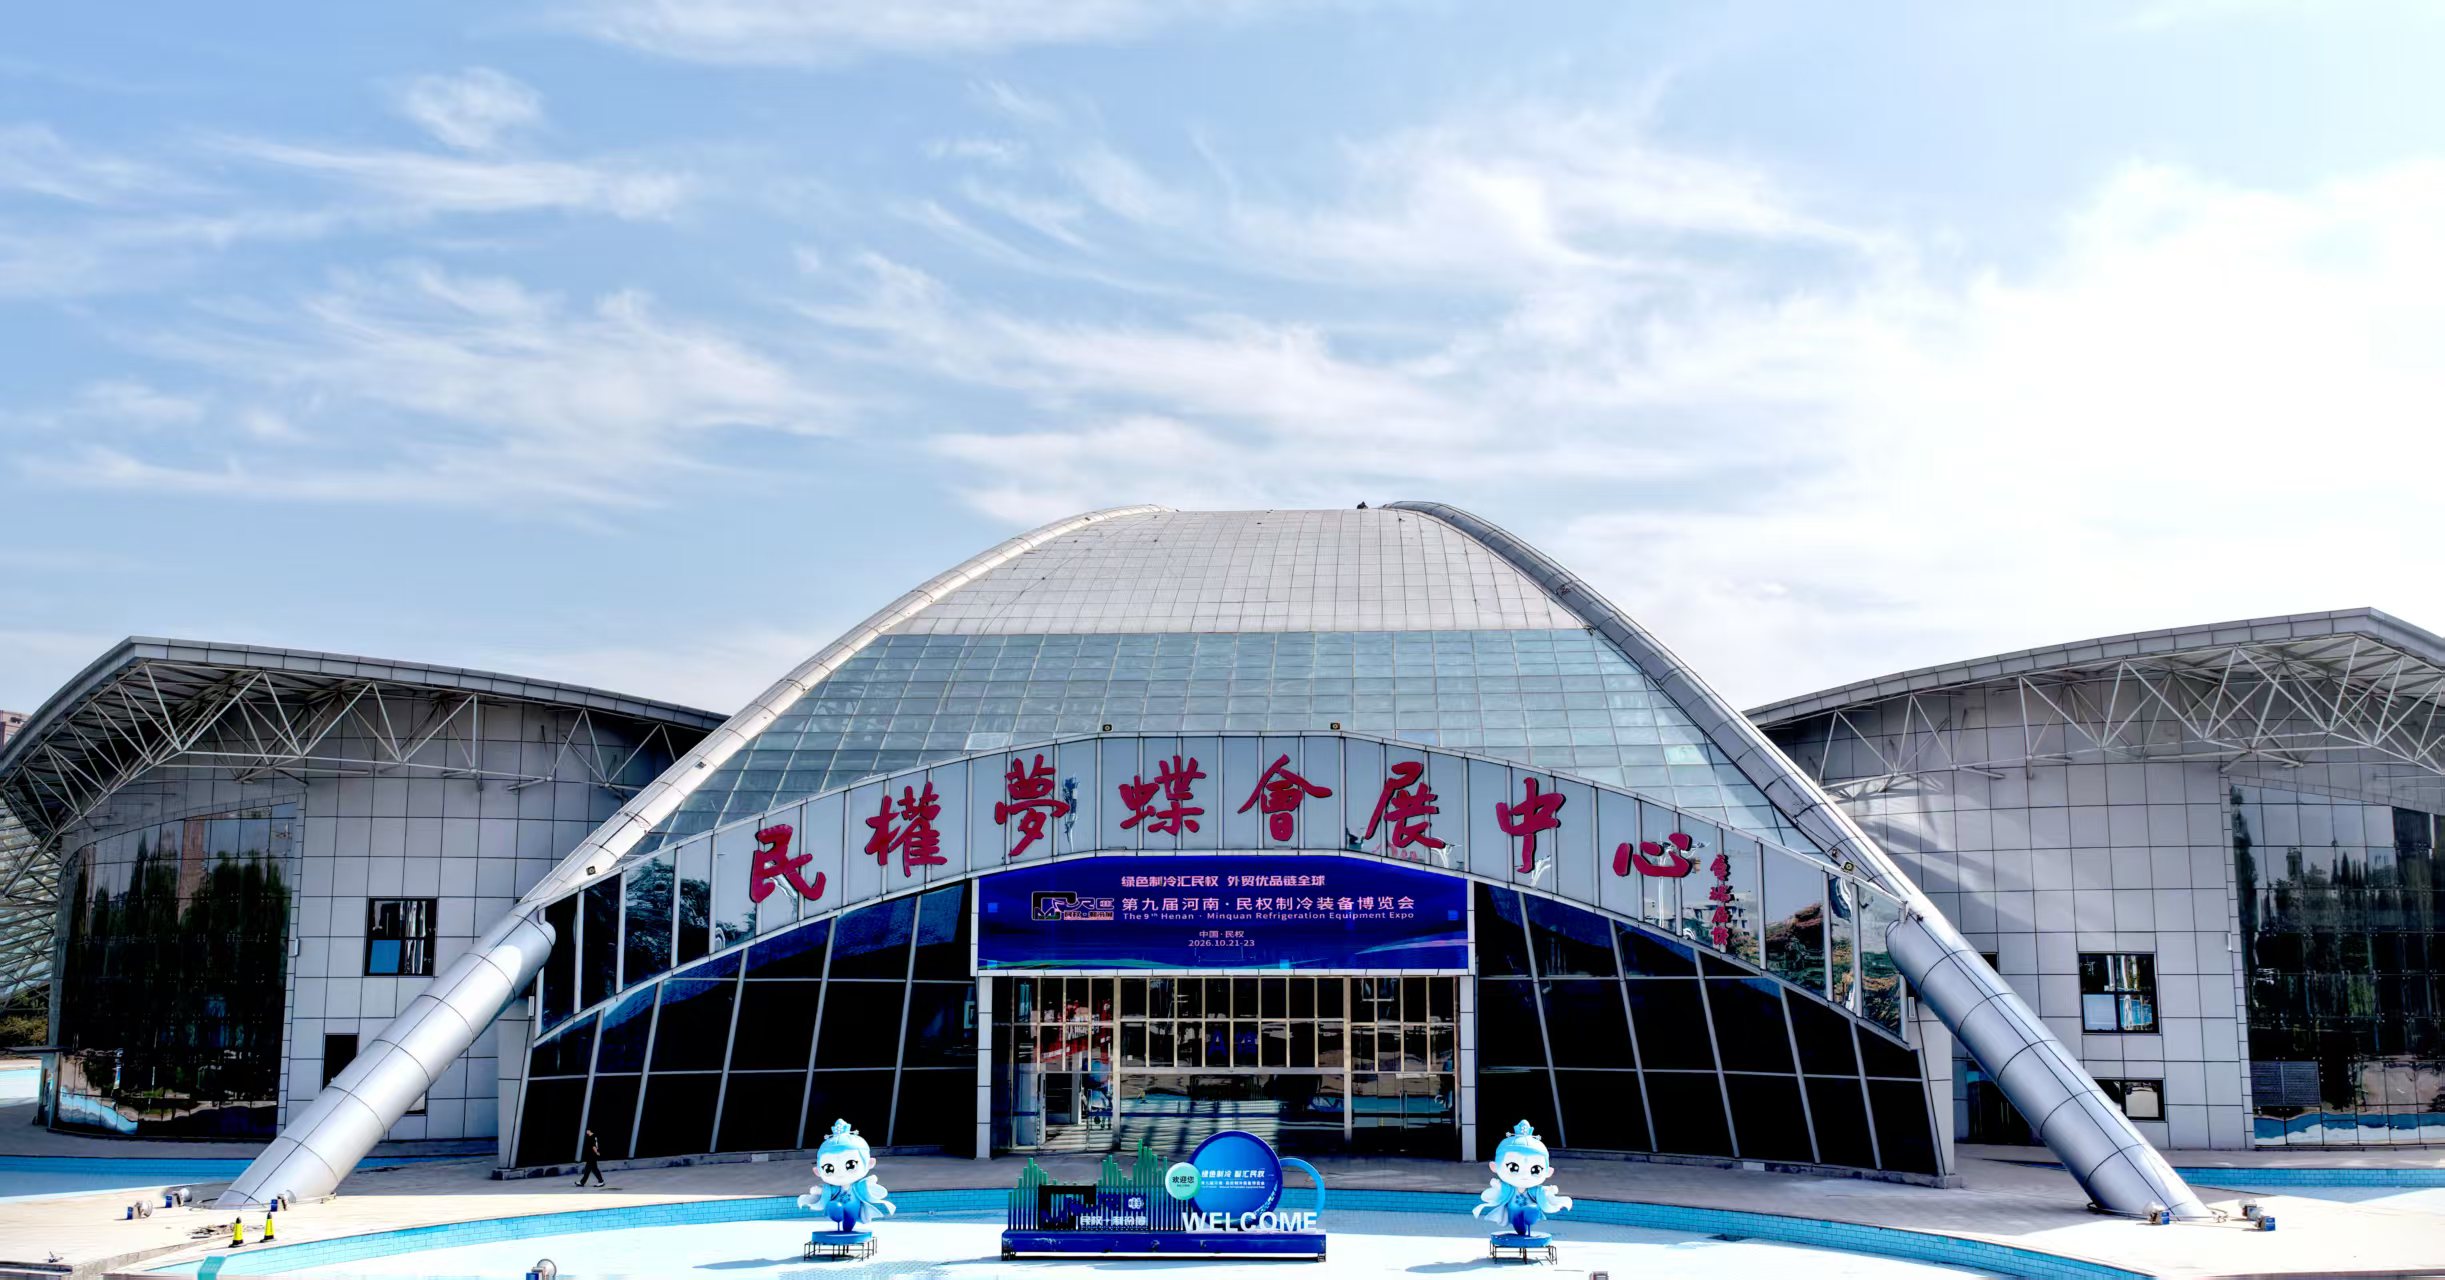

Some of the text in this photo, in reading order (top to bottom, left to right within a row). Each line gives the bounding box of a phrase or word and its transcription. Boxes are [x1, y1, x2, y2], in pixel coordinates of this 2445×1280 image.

[750, 753, 1694, 905] 民權夢蝶會展中心
[1121, 875, 1326, 888] 绿色制冷汇民权 外贸优品链全球
[1121, 895, 1415, 911] 第九届河南·民权制冷装备博览会
[1207, 912, 1252, 921] Minquan
[1255, 912, 1326, 921] Refrigeration
[1329, 911, 1386, 920] Equipment
[1389, 911, 1414, 920] Expo
[1199, 930, 1245, 938] 中国·民权
[1188, 939, 1255, 947] 2026.10.21-23
[1172, 1175, 1195, 1184] 欢迎您
[1181, 1211, 1318, 1232] WELCOME
